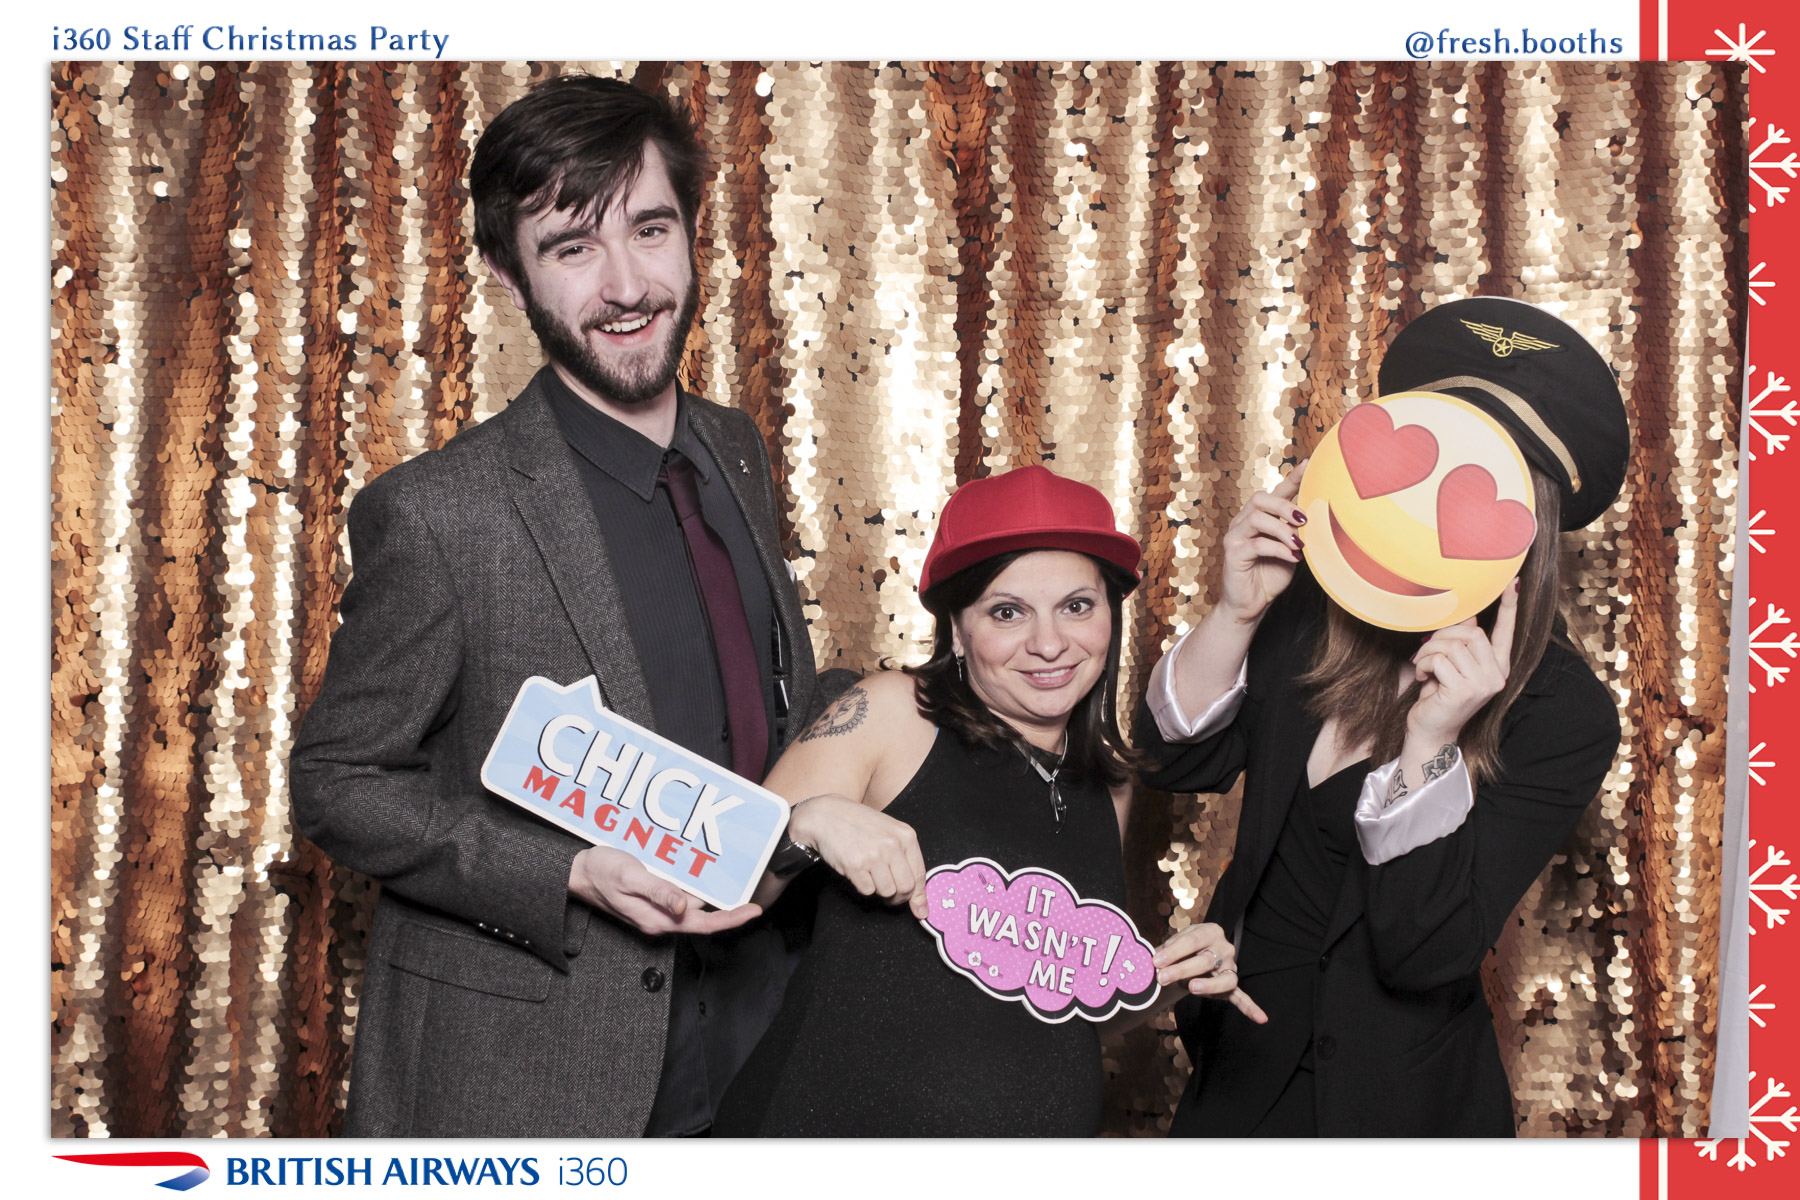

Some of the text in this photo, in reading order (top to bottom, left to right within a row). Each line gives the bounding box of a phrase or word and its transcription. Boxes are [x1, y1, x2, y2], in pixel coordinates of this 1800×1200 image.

[537, 714, 745, 857] CHICK
[522, 765, 717, 879] MAGNET
[1026, 885, 1056, 918] IT
[968, 903, 1098, 967] WASN'T
[1028, 960, 1076, 996] ME
